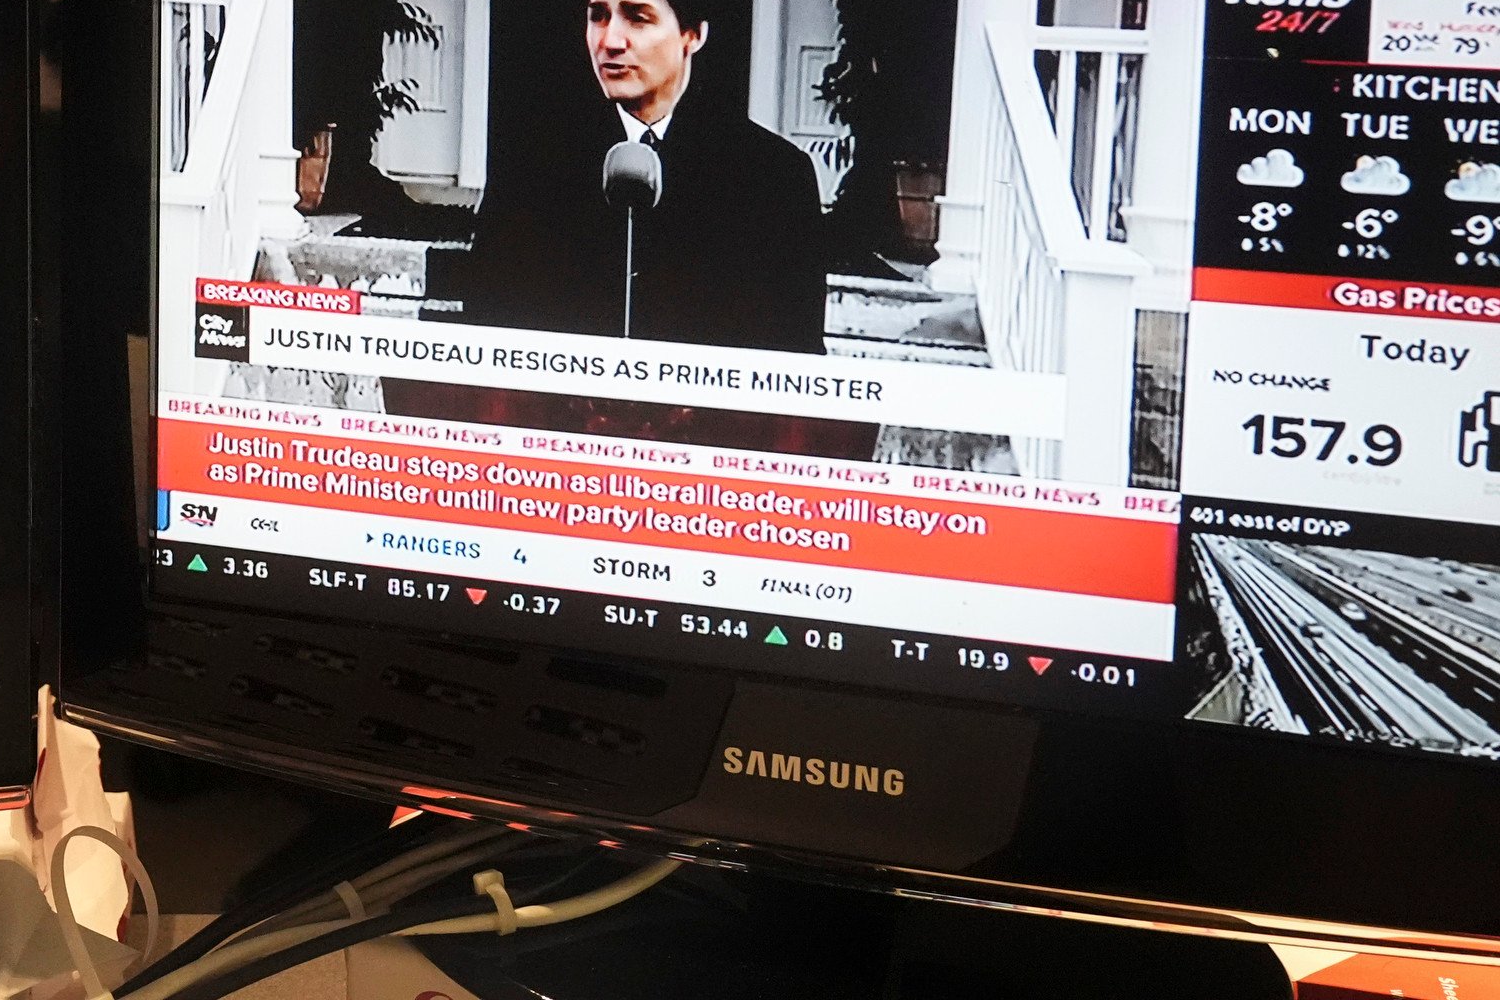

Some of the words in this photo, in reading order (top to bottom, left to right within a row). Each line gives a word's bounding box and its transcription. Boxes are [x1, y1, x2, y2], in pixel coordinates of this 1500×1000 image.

[1255, 10, 1341, 33] 24/7
[1382, 34, 1411, 52] 20
[1352, 73, 1500, 104] KITCHEN
[1229, 107, 1311, 135] MON
[1340, 112, 1410, 141] TUE
[1444, 117, 1500, 145] WE
[1238, 201, 1293, 232] -8°
[1342, 208, 1399, 239] -6°
[203, 283, 296, 307] BREAKING
[297, 293, 352, 312] NEWS
[1333, 282, 1396, 309] Gas
[1403, 287, 1500, 317] Prices
[199, 314, 234, 334] City
[199, 330, 246, 348] News
[264, 328, 351, 352] JUSTIN
[360, 336, 483, 365] TRUDEAU
[492, 348, 605, 376] RESIGNS
[613, 360, 649, 381] AS
[659, 363, 741, 389] PRIME
[751, 371, 883, 401] MINISTER
[1360, 334, 1471, 371] Today
[1213, 370, 1243, 384] NO
[1249, 372, 1331, 392] CHANGE
[168, 399, 261, 421] BREAKING
[268, 411, 322, 428] NEWS
[341, 418, 438, 440] BREAKING
[445, 428, 502, 446] NEWS
[523, 436, 625, 459] BREAKING
[632, 447, 691, 465] NEWS
[713, 454, 821, 478] BREAKING
[829, 466, 890, 485] NEWS
[913, 475, 1026, 499] BREAKING
[1035, 486, 1101, 507] NEWS
[1242, 414, 1402, 467] 157.9
[209, 432, 284, 460] Justin
[291, 440, 399, 472] Trudeau
[407, 456, 479, 484] steps
[486, 462, 562, 490] down
[570, 475, 602, 495] as
[609, 474, 704, 505] Liberal
[712, 484, 812, 520] leader,
[820, 499, 869, 523] will
[876, 504, 940, 536] stay
[946, 515, 987, 535] on
[209, 463, 238, 482] as
[245, 463, 319, 492] Prime
[326, 472, 430, 504] Minister
[437, 489, 495, 512] until
[502, 496, 561, 519] new
[567, 503, 638, 533] party
[646, 507, 737, 538] leader
[744, 519, 850, 551] chosen
[382, 533, 481, 558] RANGERS
[513, 548, 527, 564] 4
[593, 557, 671, 581] STORM
[702, 569, 717, 587] 3
[223, 557, 269, 579] 3.36
[309, 568, 367, 591] SLF-T
[387, 578, 450, 602] 85.17
[503, 594, 560, 615] -0.37
[604, 605, 658, 628] SU-T
[680, 614, 748, 639] 53.44
[805, 629, 842, 651] 0.8
[891, 639, 929, 662] T-T
[958, 648, 1010, 671] 19.9
[1071, 663, 1136, 688] -0.01
[723, 746, 904, 796] SAMSUNG
